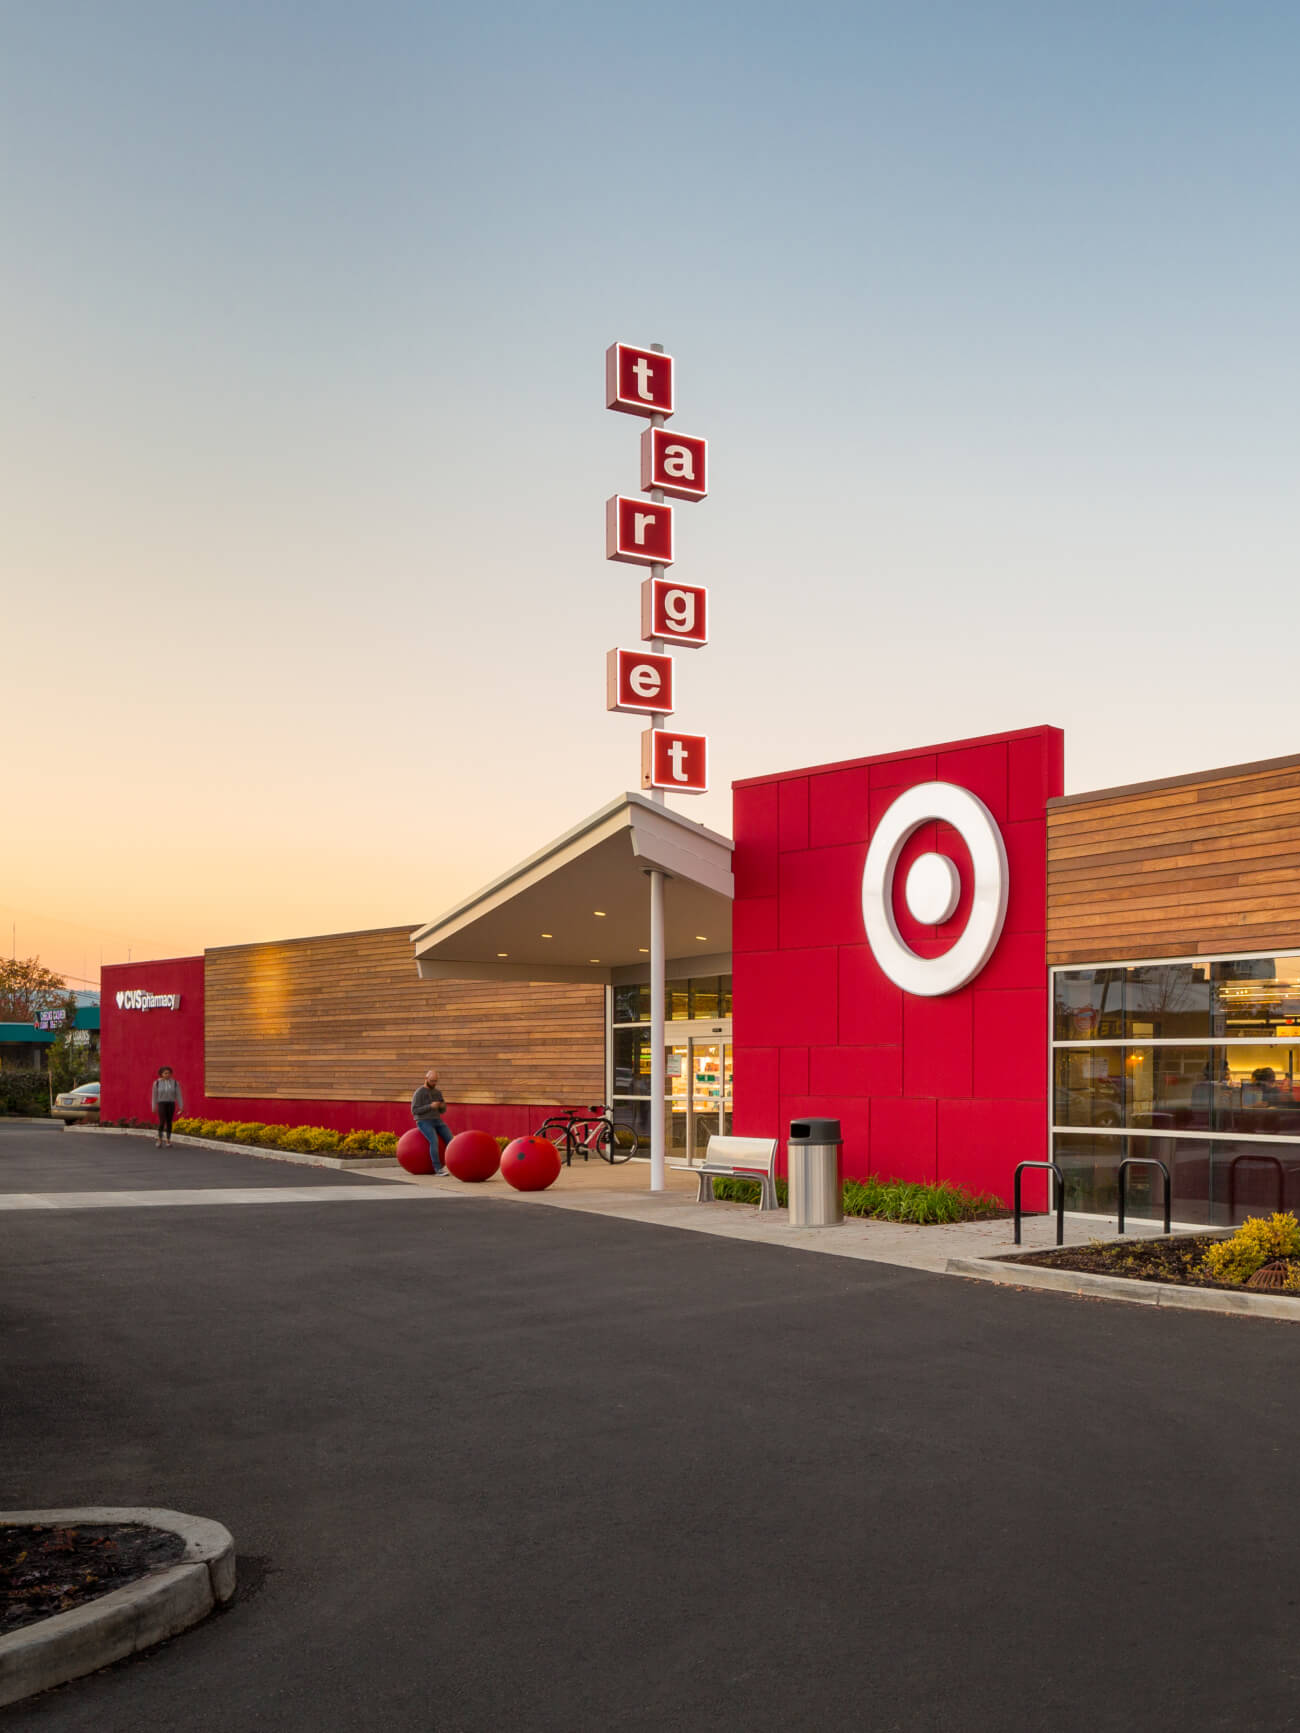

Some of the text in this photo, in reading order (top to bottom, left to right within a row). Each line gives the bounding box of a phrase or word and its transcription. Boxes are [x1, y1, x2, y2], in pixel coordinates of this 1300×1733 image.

[629, 357, 695, 782] target
[124, 990, 175, 1012] CVS pharmacy
